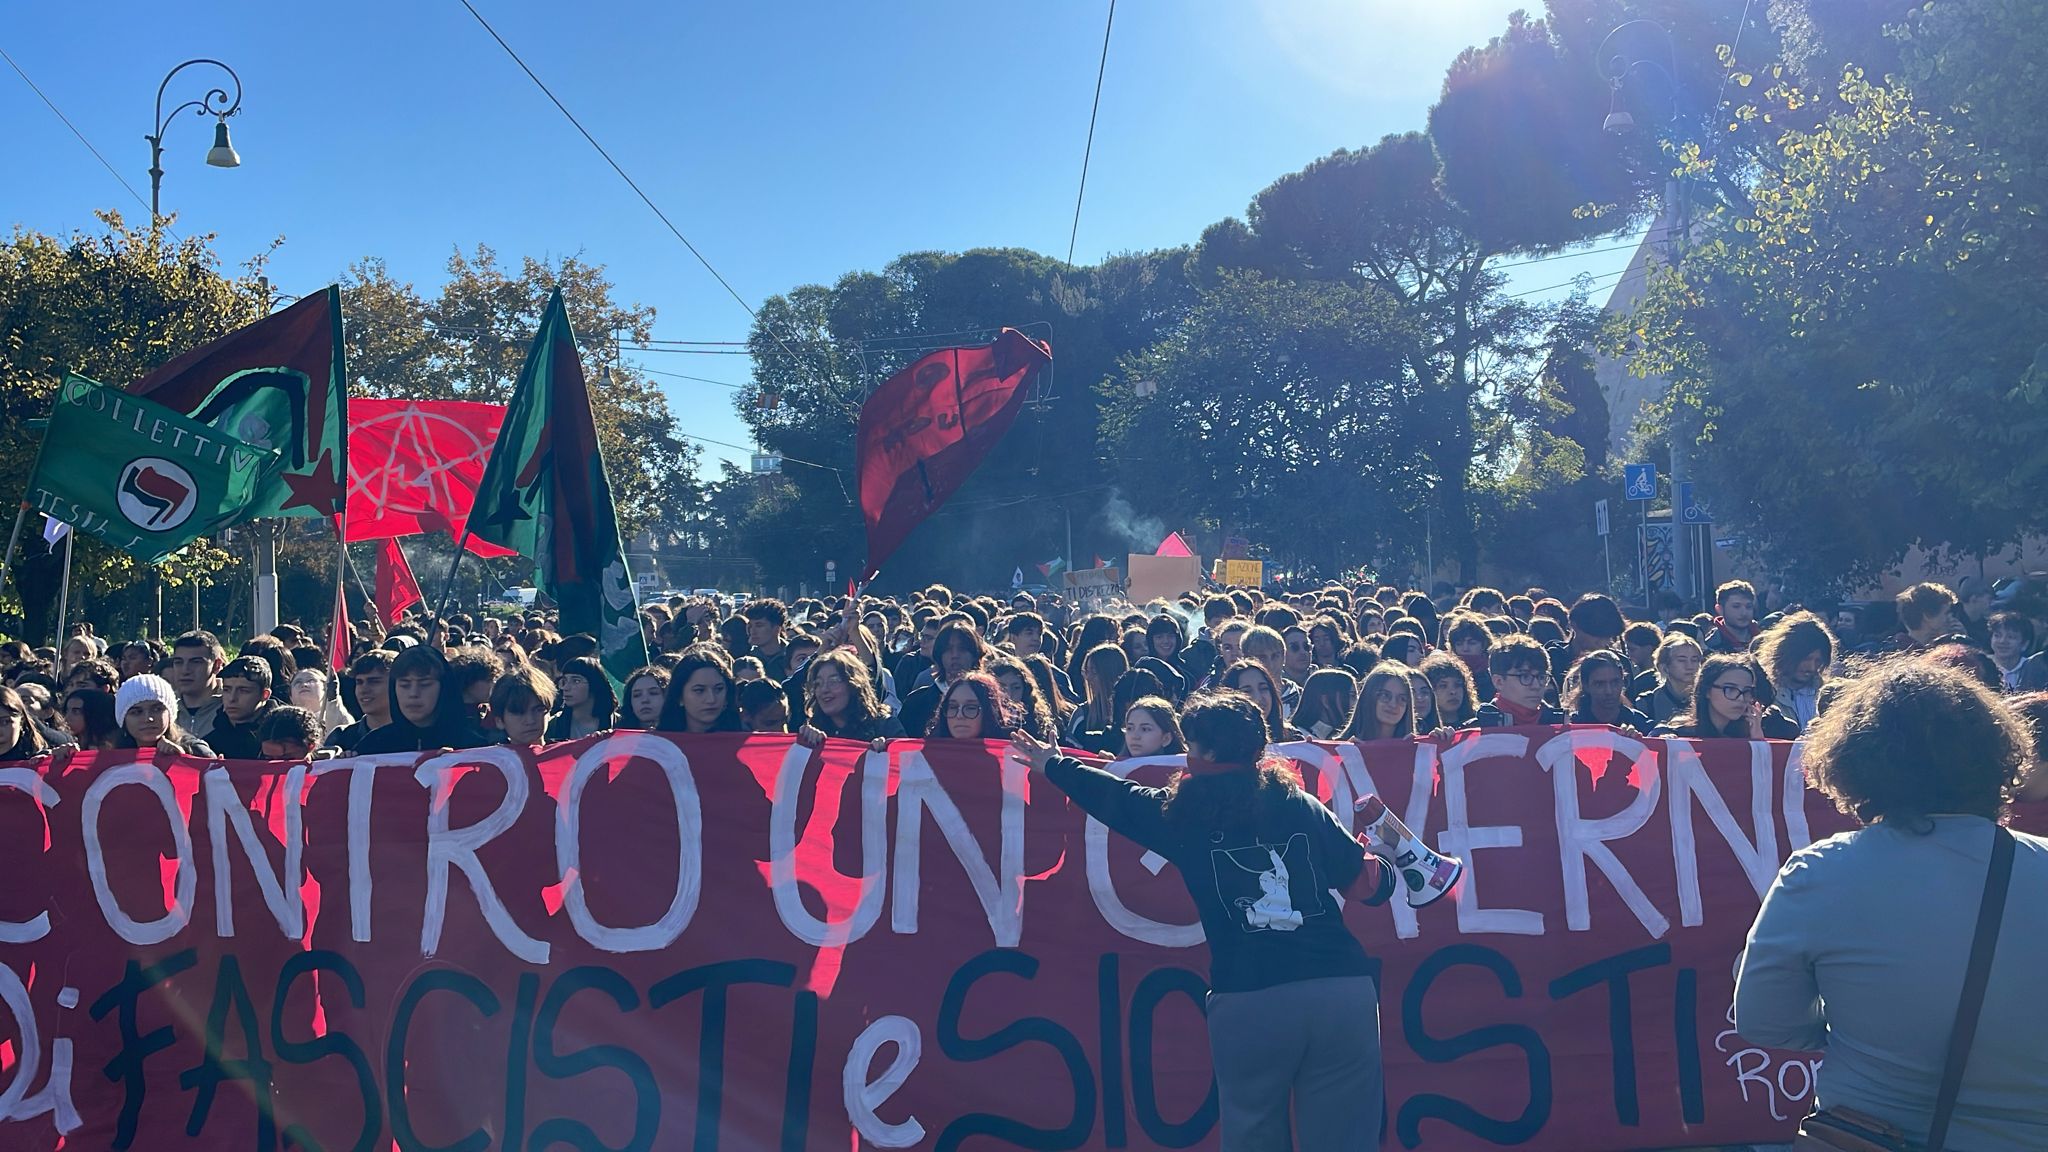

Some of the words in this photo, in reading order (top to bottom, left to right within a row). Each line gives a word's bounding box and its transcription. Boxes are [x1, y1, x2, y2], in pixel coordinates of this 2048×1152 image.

[67, 380, 254, 473] COLLETTIV
[769, 742, 1025, 948] UN
[1086, 729, 1812, 949] GVERN
[89, 948, 819, 1152] FASCISTI
[843, 1014, 926, 1148] e
